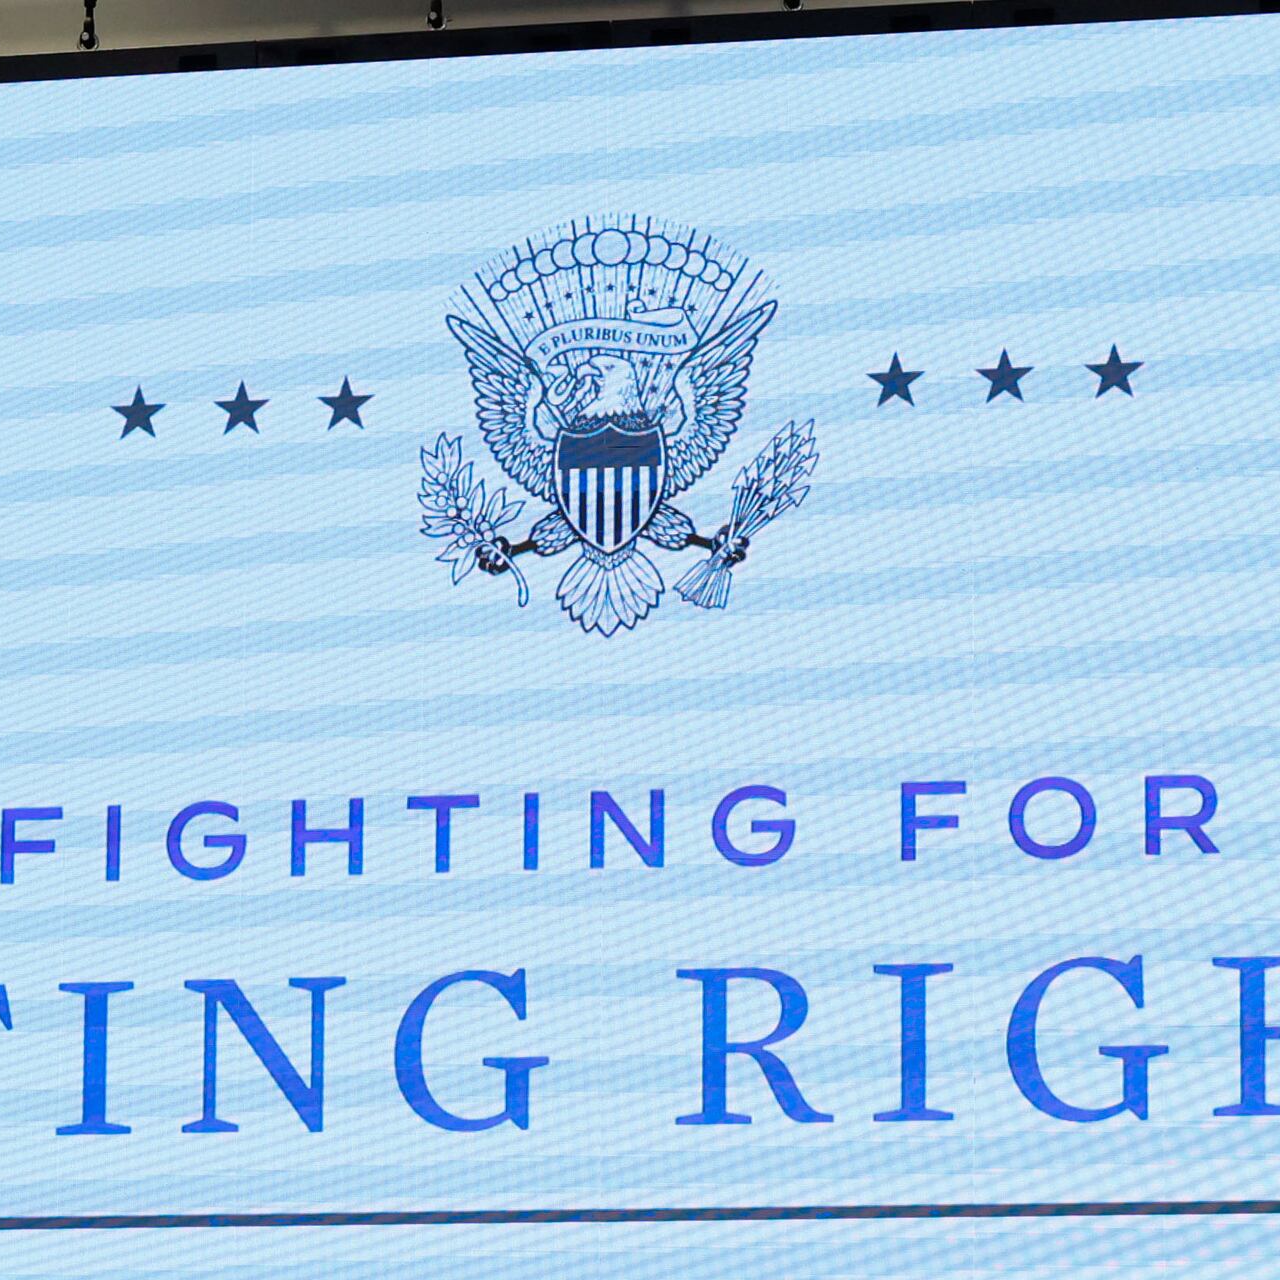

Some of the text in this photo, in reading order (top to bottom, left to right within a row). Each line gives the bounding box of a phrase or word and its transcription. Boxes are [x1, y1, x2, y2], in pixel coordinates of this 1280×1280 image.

[538, 327, 688, 356] E PLURIBUS UNUM
[0, 774, 1221, 885] FIGHTING FOR
